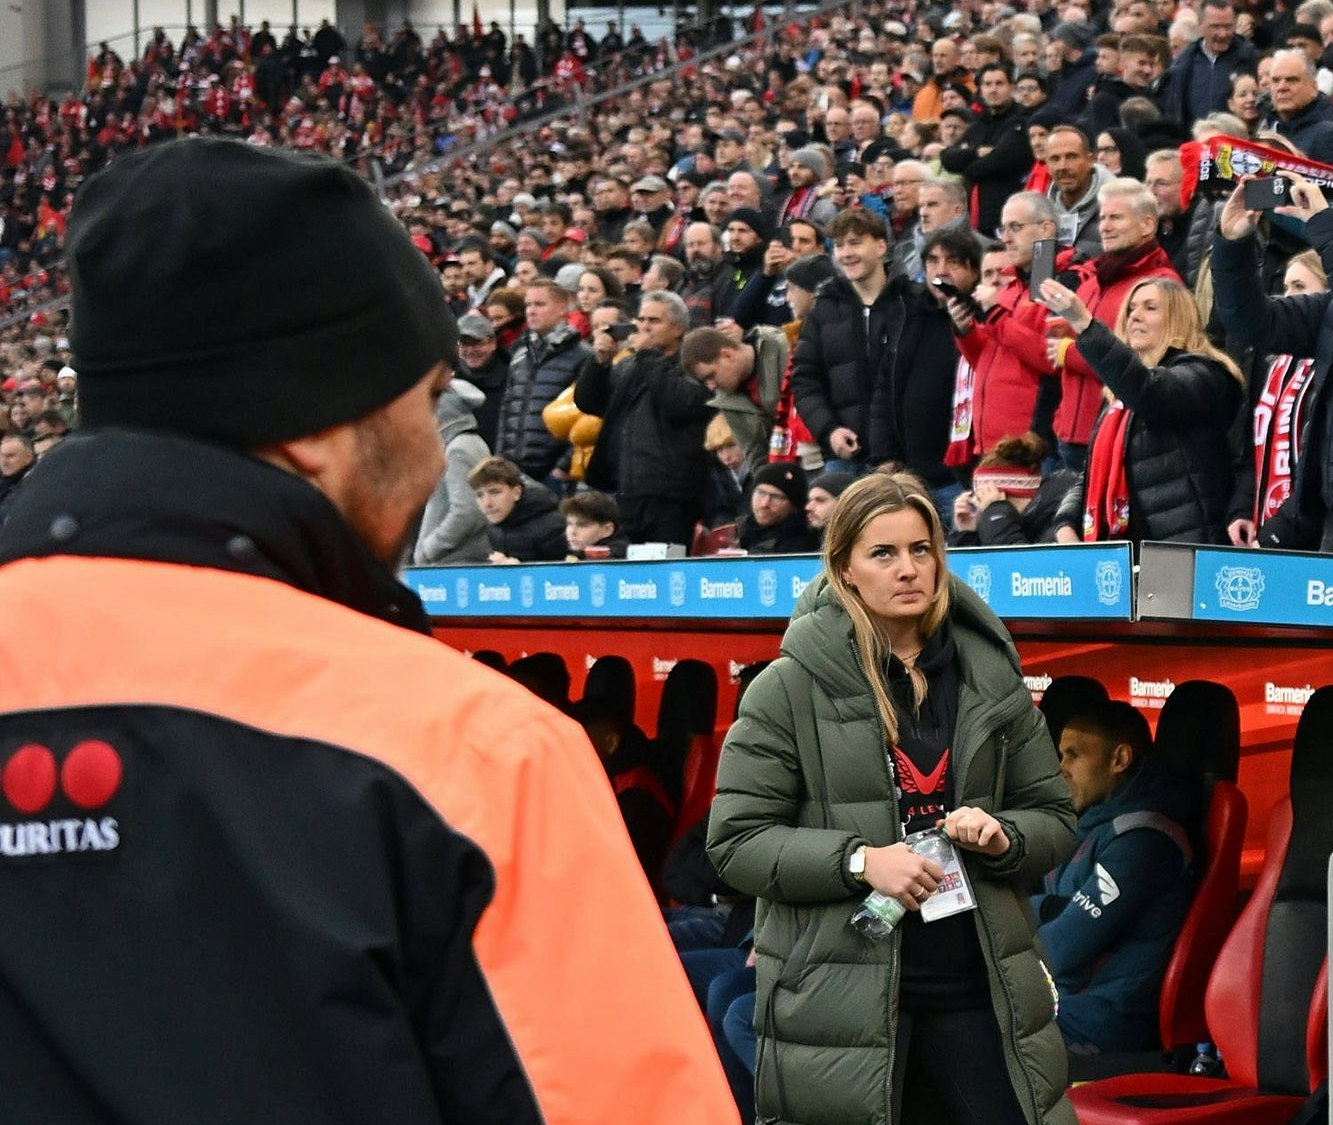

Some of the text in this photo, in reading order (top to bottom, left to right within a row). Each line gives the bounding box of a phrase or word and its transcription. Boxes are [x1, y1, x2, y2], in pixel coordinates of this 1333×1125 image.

[701, 577, 743, 599] Barmenia
[1011, 571, 1072, 597] Barmenia
[0, 816, 121, 858] URITAS
